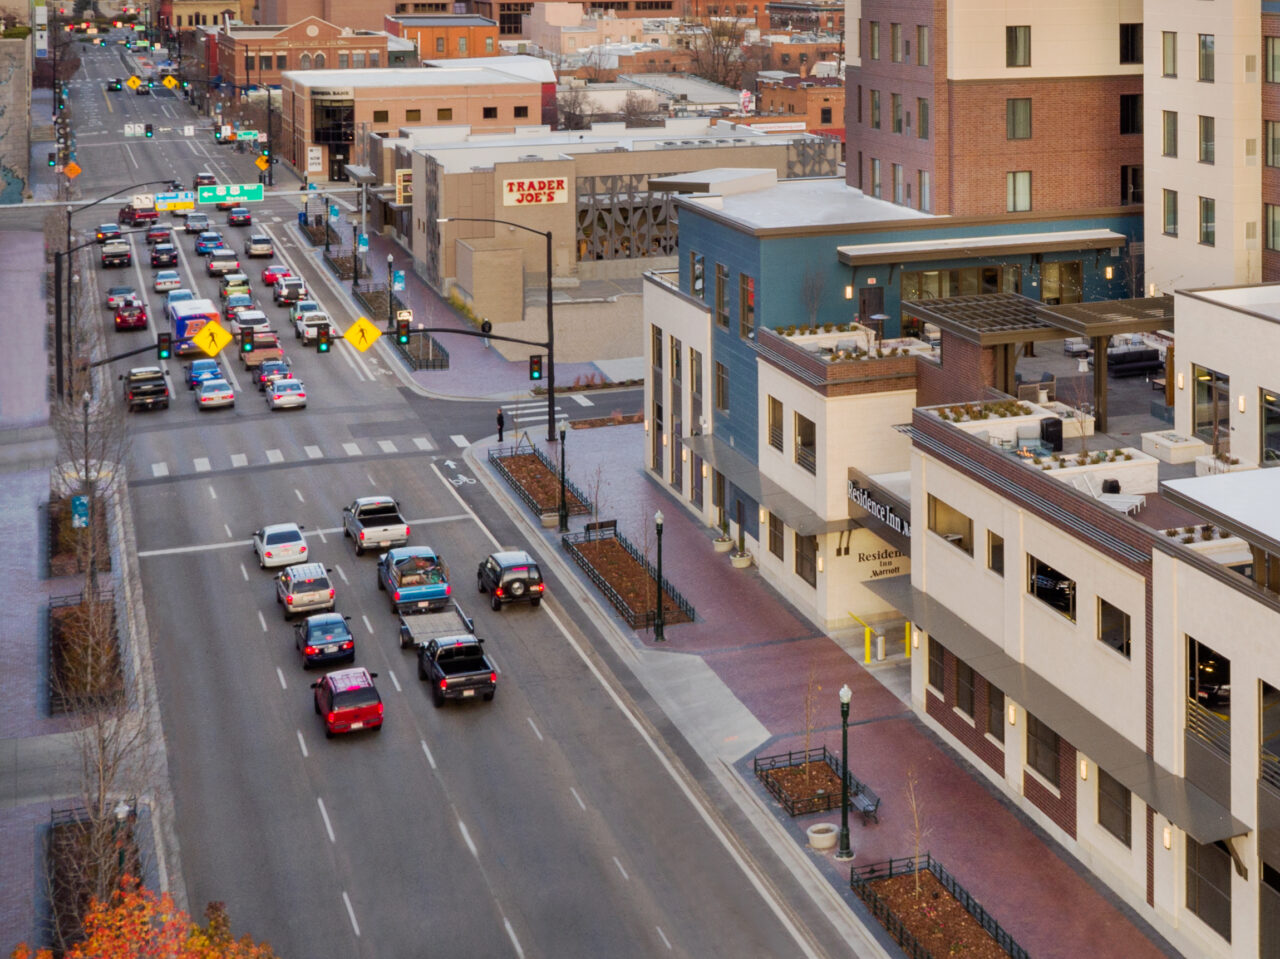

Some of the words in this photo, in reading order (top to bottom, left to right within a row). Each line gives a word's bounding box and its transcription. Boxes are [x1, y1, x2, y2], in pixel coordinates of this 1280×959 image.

[506, 179, 565, 193] TRADER
[515, 191, 555, 204] JOE'S
[848, 480, 885, 521] Residence
[886, 505, 901, 532] Inn
[858, 549, 905, 562] Residen
[870, 566, 900, 578] Marriott
